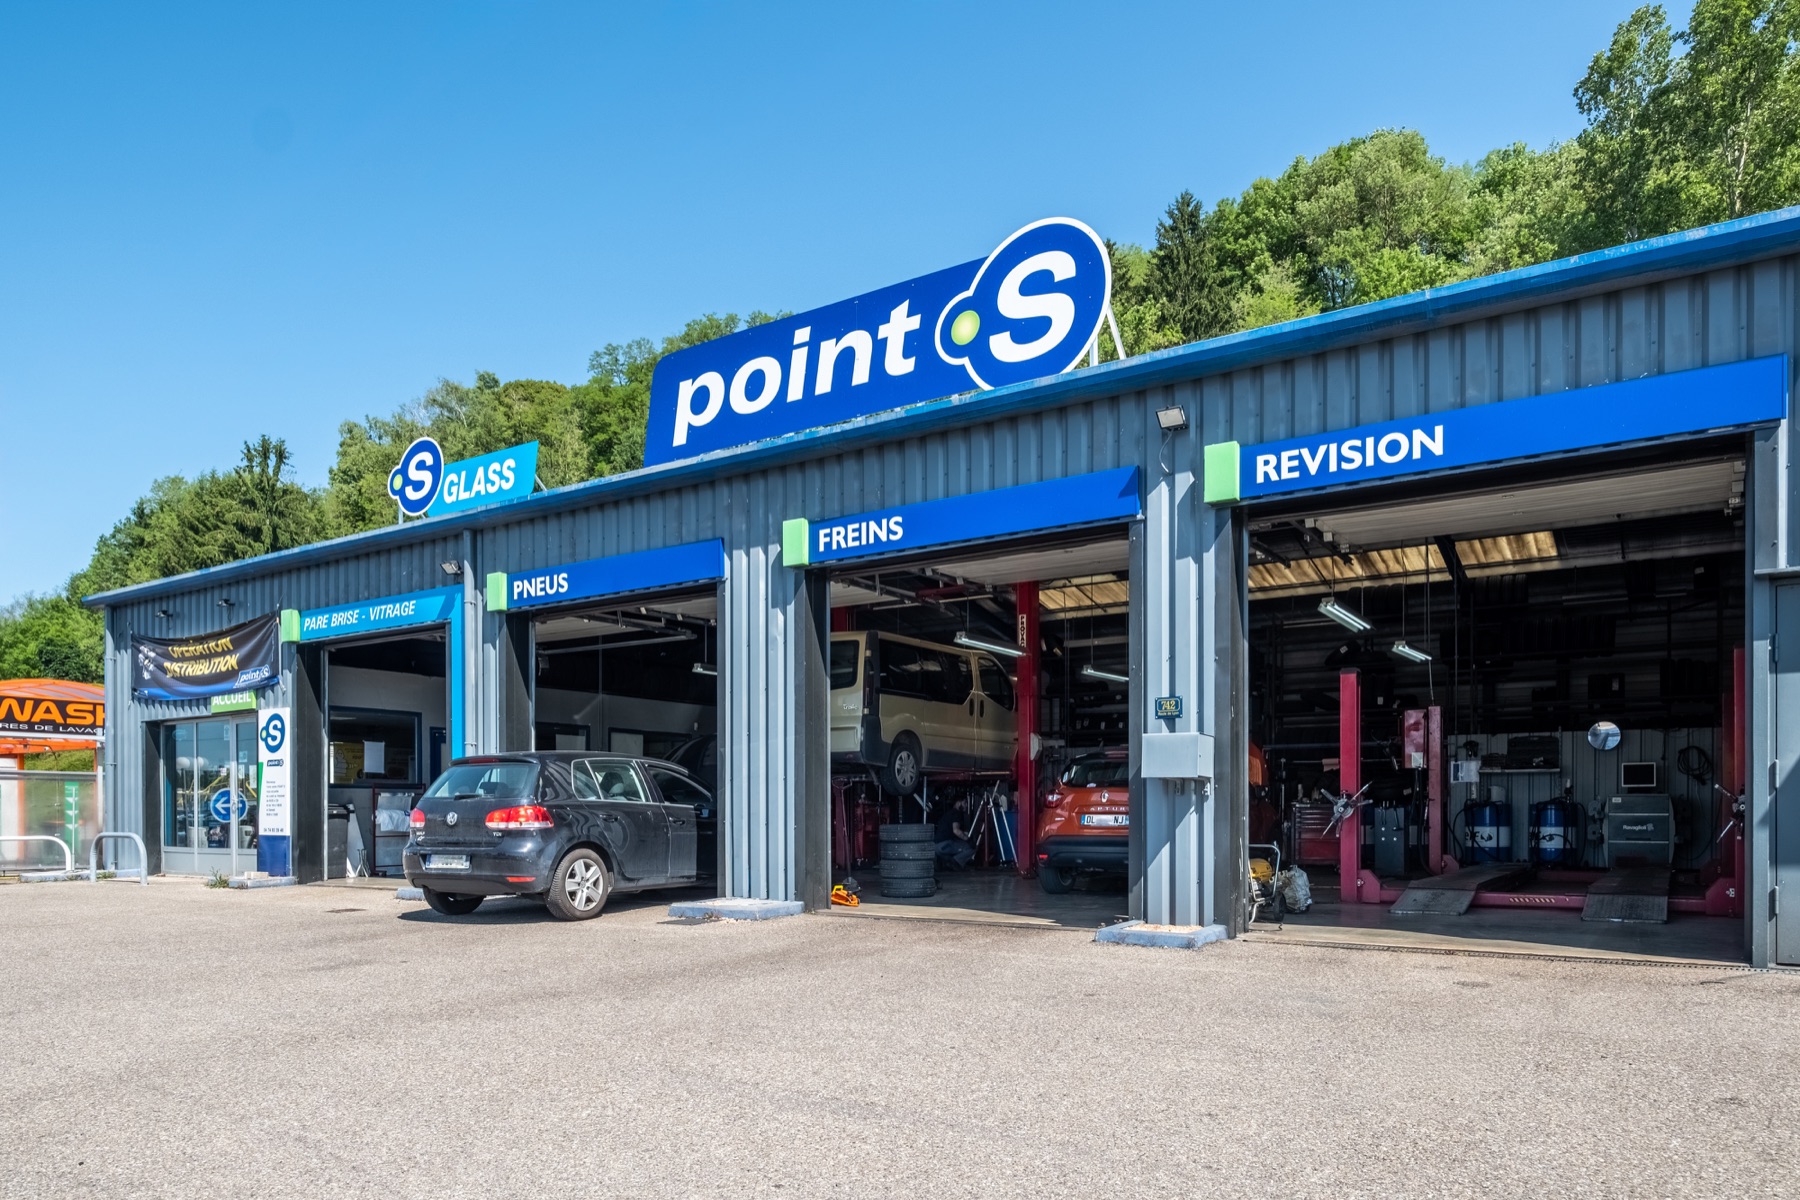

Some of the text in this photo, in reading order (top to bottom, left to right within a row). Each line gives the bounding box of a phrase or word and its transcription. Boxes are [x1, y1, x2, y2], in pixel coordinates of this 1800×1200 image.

[672, 250, 1076, 447] point S
[1256, 424, 1444, 484] REVISION
[405, 452, 516, 504] S GLASS
[818, 515, 904, 553] FREINS
[513, 572, 569, 600] PNEUS
[303, 614, 329, 632] PARE
[330, 609, 360, 627] BRISE
[369, 600, 416, 621] VITRAGE
[163, 653, 239, 678] DISTRIBUTION
[240, 671, 260, 683] point
[212, 690, 252, 706] ACCUEIL
[1161, 700, 1176, 710] 742
[34, 724, 54, 732] DE
[59, 726, 105, 734] LAVA
